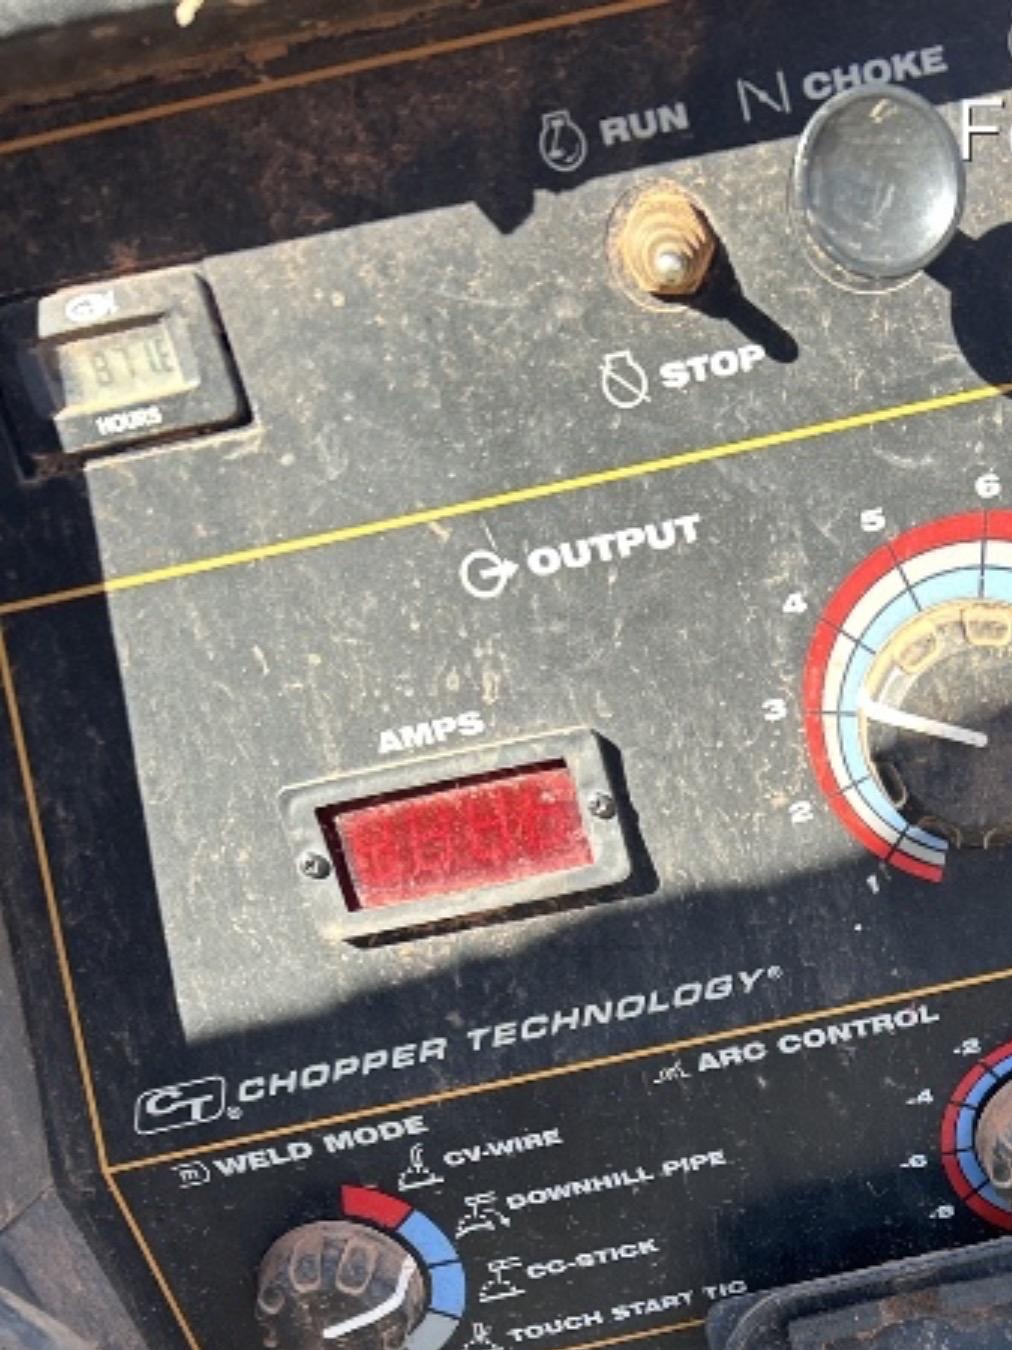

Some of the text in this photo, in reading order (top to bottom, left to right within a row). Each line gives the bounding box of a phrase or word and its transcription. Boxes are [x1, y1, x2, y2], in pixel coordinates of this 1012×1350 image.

[803, 47, 947, 99] CHOKE
[600, 104, 689, 146] RUN
[659, 344, 765, 390] STOP
[95, 405, 162, 436] HOURS
[975, 474, 1000, 497] 6
[860, 508, 885, 531] 5
[527, 513, 701, 577] OUTPUT
[782, 593, 808, 614] 4
[763, 699, 787, 721] 3
[378, 711, 485, 756] AMPS
[791, 801, 813, 823] 2
[866, 875, 879, 895] 1
[698, 1005, 940, 1072] ARC CONTROL
[953, 1038, 981, 1056] -2
[238, 1037, 447, 1102] CHOPPER
[906, 1089, 934, 1106] -4
[213, 1115, 428, 1178] WELD MODE
[443, 1128, 563, 1167] CV-WIRE
[505, 1150, 727, 1211] DOWNHILL PIPE
[527, 1238, 659, 1280] CC-STICK
[506, 1279, 748, 1343] TOUCH START TIG
